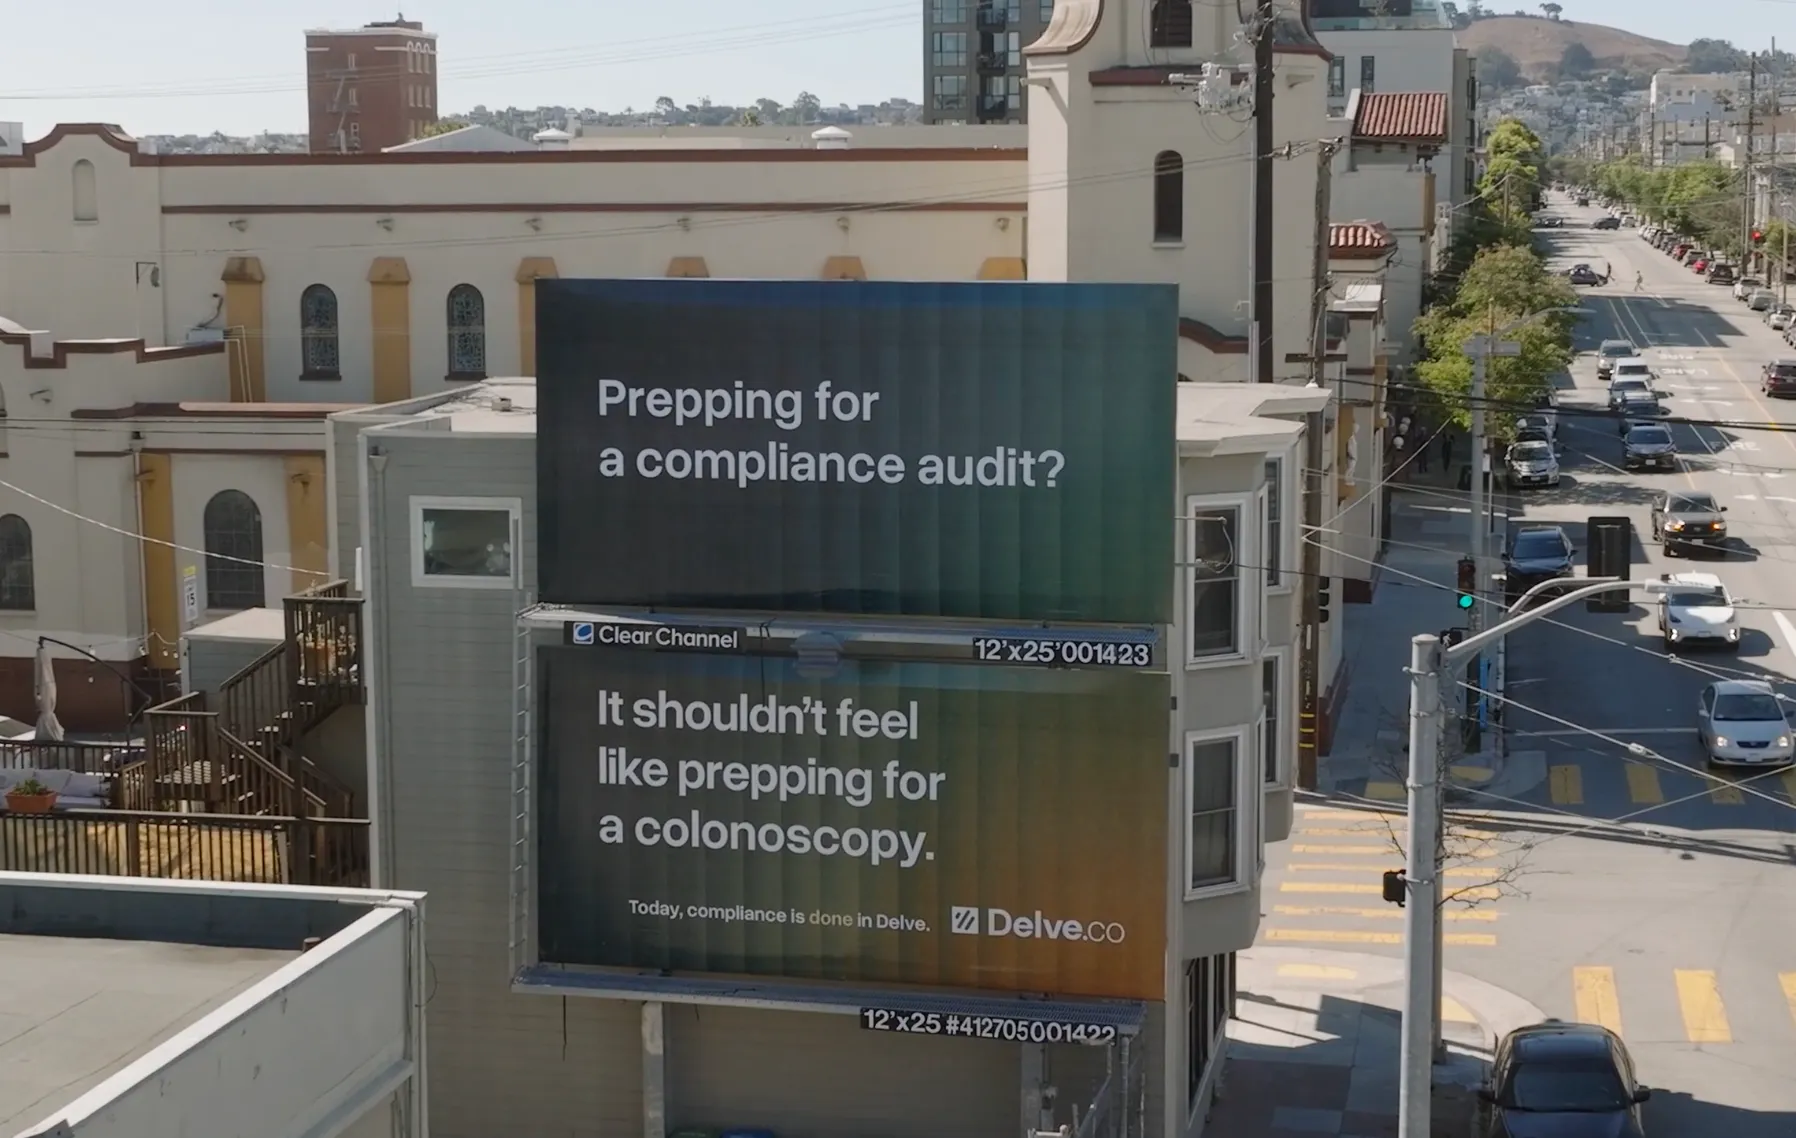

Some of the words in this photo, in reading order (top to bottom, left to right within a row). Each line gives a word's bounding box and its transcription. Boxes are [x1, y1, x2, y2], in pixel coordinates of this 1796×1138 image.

[598, 379, 802, 430] Prepping
[814, 380, 880, 421] for
[599, 447, 625, 477] a
[636, 441, 906, 488] compliance
[918, 446, 1065, 488] audit?
[599, 625, 652, 645] Clear
[655, 627, 738, 649] Channel
[599, 690, 624, 726] It
[633, 690, 827, 735] shouldn't
[836, 698, 918, 740] feel
[599, 746, 669, 787] like
[678, 757, 873, 807] prepping
[883, 760, 946, 801] for
[599, 814, 624, 844] a
[635, 809, 935, 868] colonoscopy.
[628, 899, 683, 920] Today,
[687, 905, 787, 923] compliance
[791, 908, 805, 924] is
[809, 909, 853, 927] done
[857, 912, 873, 928] in
[876, 914, 931, 932] Delve.
[863, 1009, 941, 1034] 12'x25
